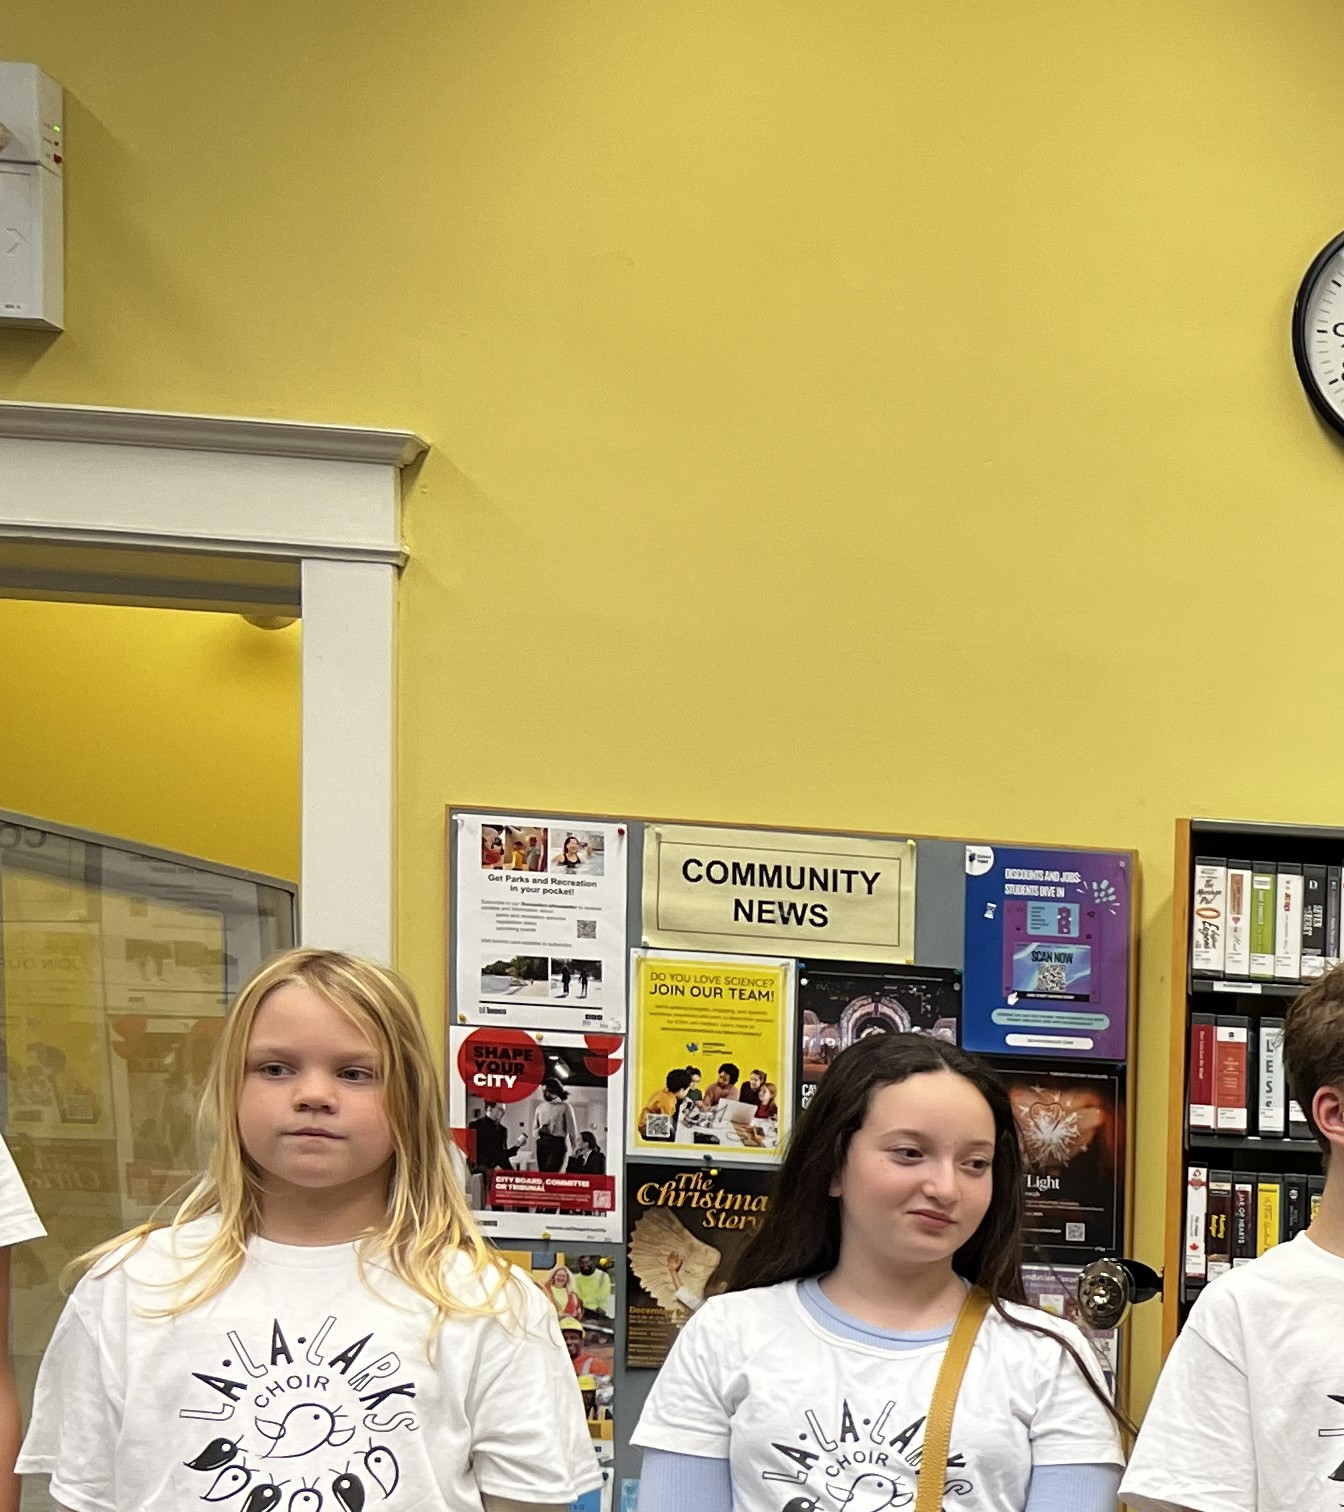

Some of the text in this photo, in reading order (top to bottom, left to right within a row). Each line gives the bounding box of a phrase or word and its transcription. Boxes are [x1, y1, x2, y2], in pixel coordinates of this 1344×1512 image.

[505, 875, 529, 884] Parks
[532, 877, 549, 885] and
[550, 878, 598, 888] Recreation
[682, 858, 881, 895] COMMUNITY
[521, 886, 540, 895] your
[733, 898, 829, 928] NEWS
[1031, 951, 1073, 964] SCAN NOW
[650, 972, 775, 988] DO YOU LOVE SCIENCE?
[649, 984, 775, 1002] JOIN OUR TEAM!
[473, 1046, 533, 1062] SHAPE
[473, 1059, 525, 1075] YOUR
[473, 1073, 517, 1088] CITY
[675, 1172, 714, 1190] The
[636, 1180, 769, 1212] Christma
[1238, 1219, 1246, 1244] HEARTS
[254, 1374, 330, 1408] CHOIR
[825, 1450, 889, 1477] CHOIR
